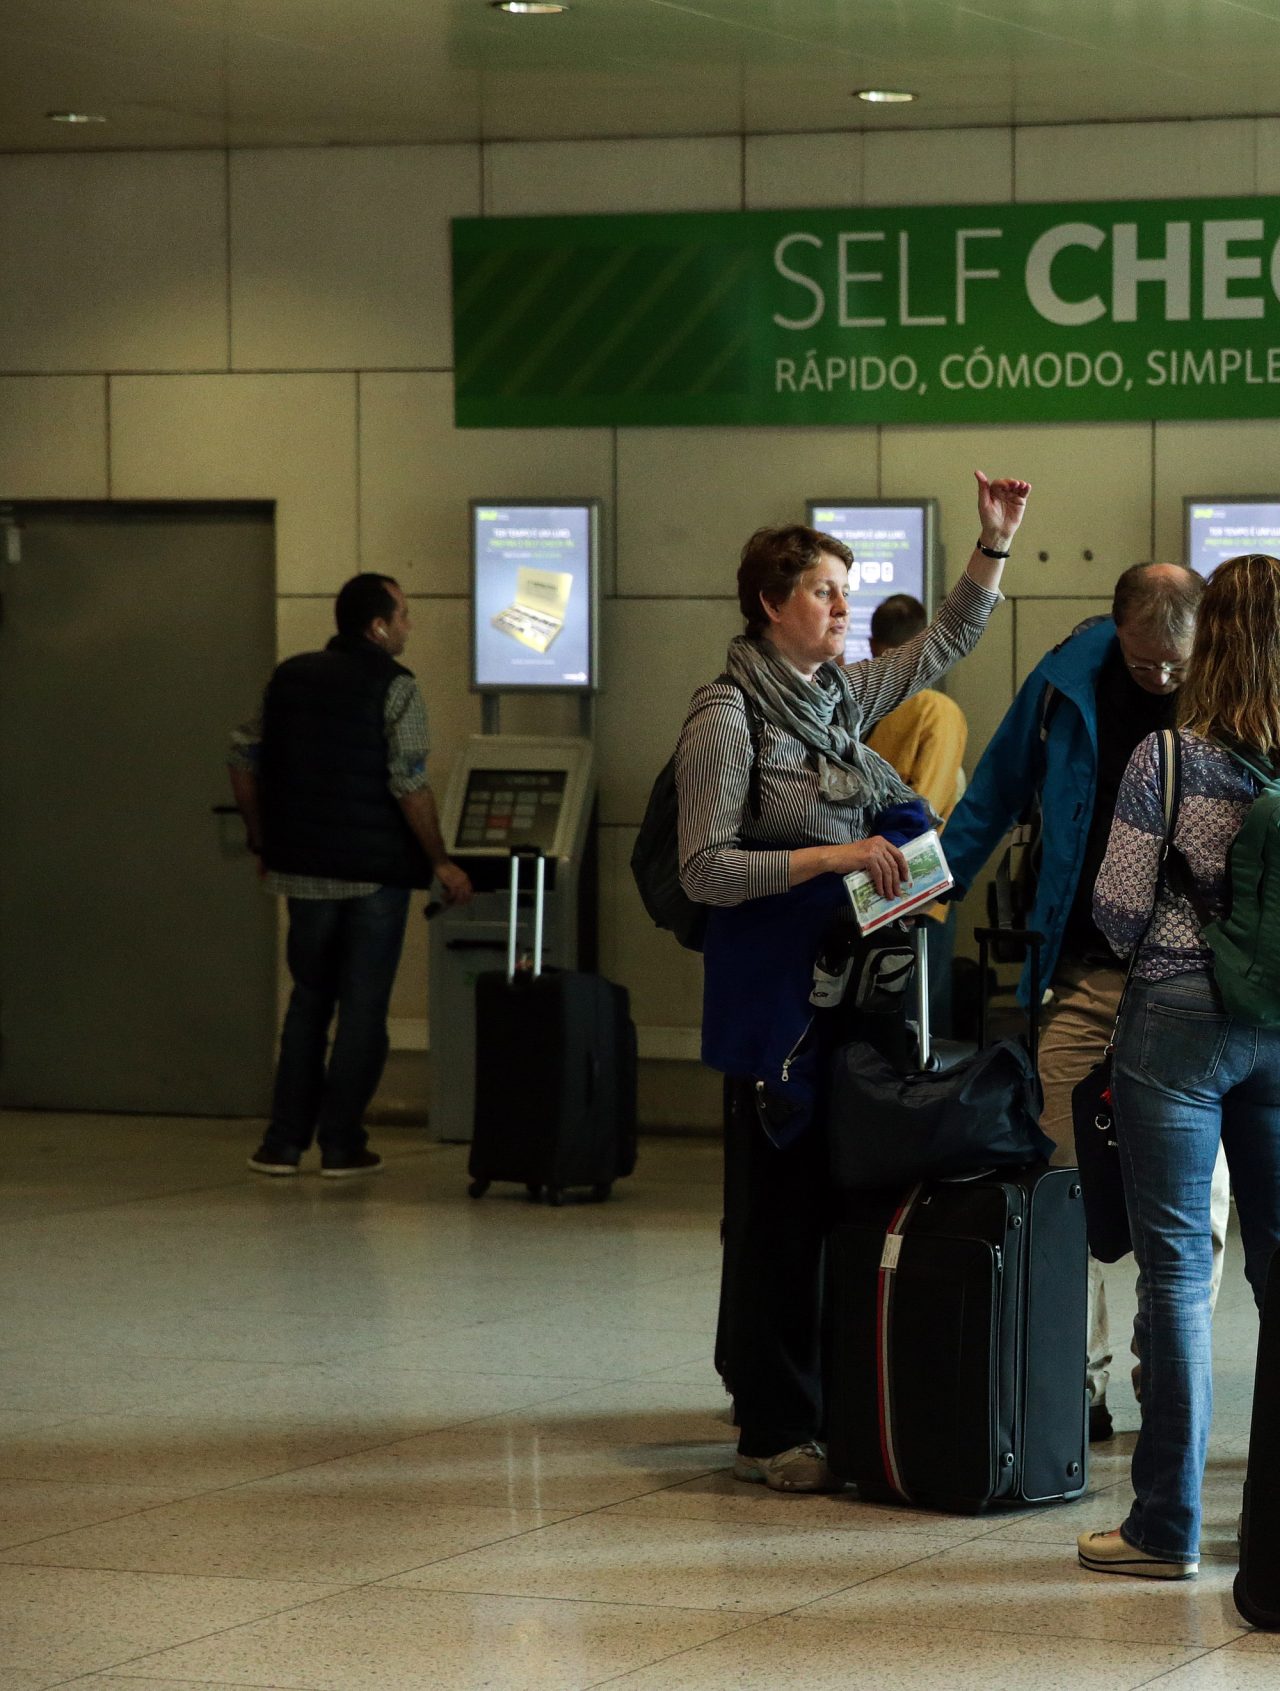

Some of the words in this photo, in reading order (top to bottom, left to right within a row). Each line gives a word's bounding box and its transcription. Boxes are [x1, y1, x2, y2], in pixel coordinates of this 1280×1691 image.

[774, 229, 1001, 328] SELF
[775, 349, 928, 395] RÁPIDO,
[939, 346, 1133, 393] CÓMODO,
